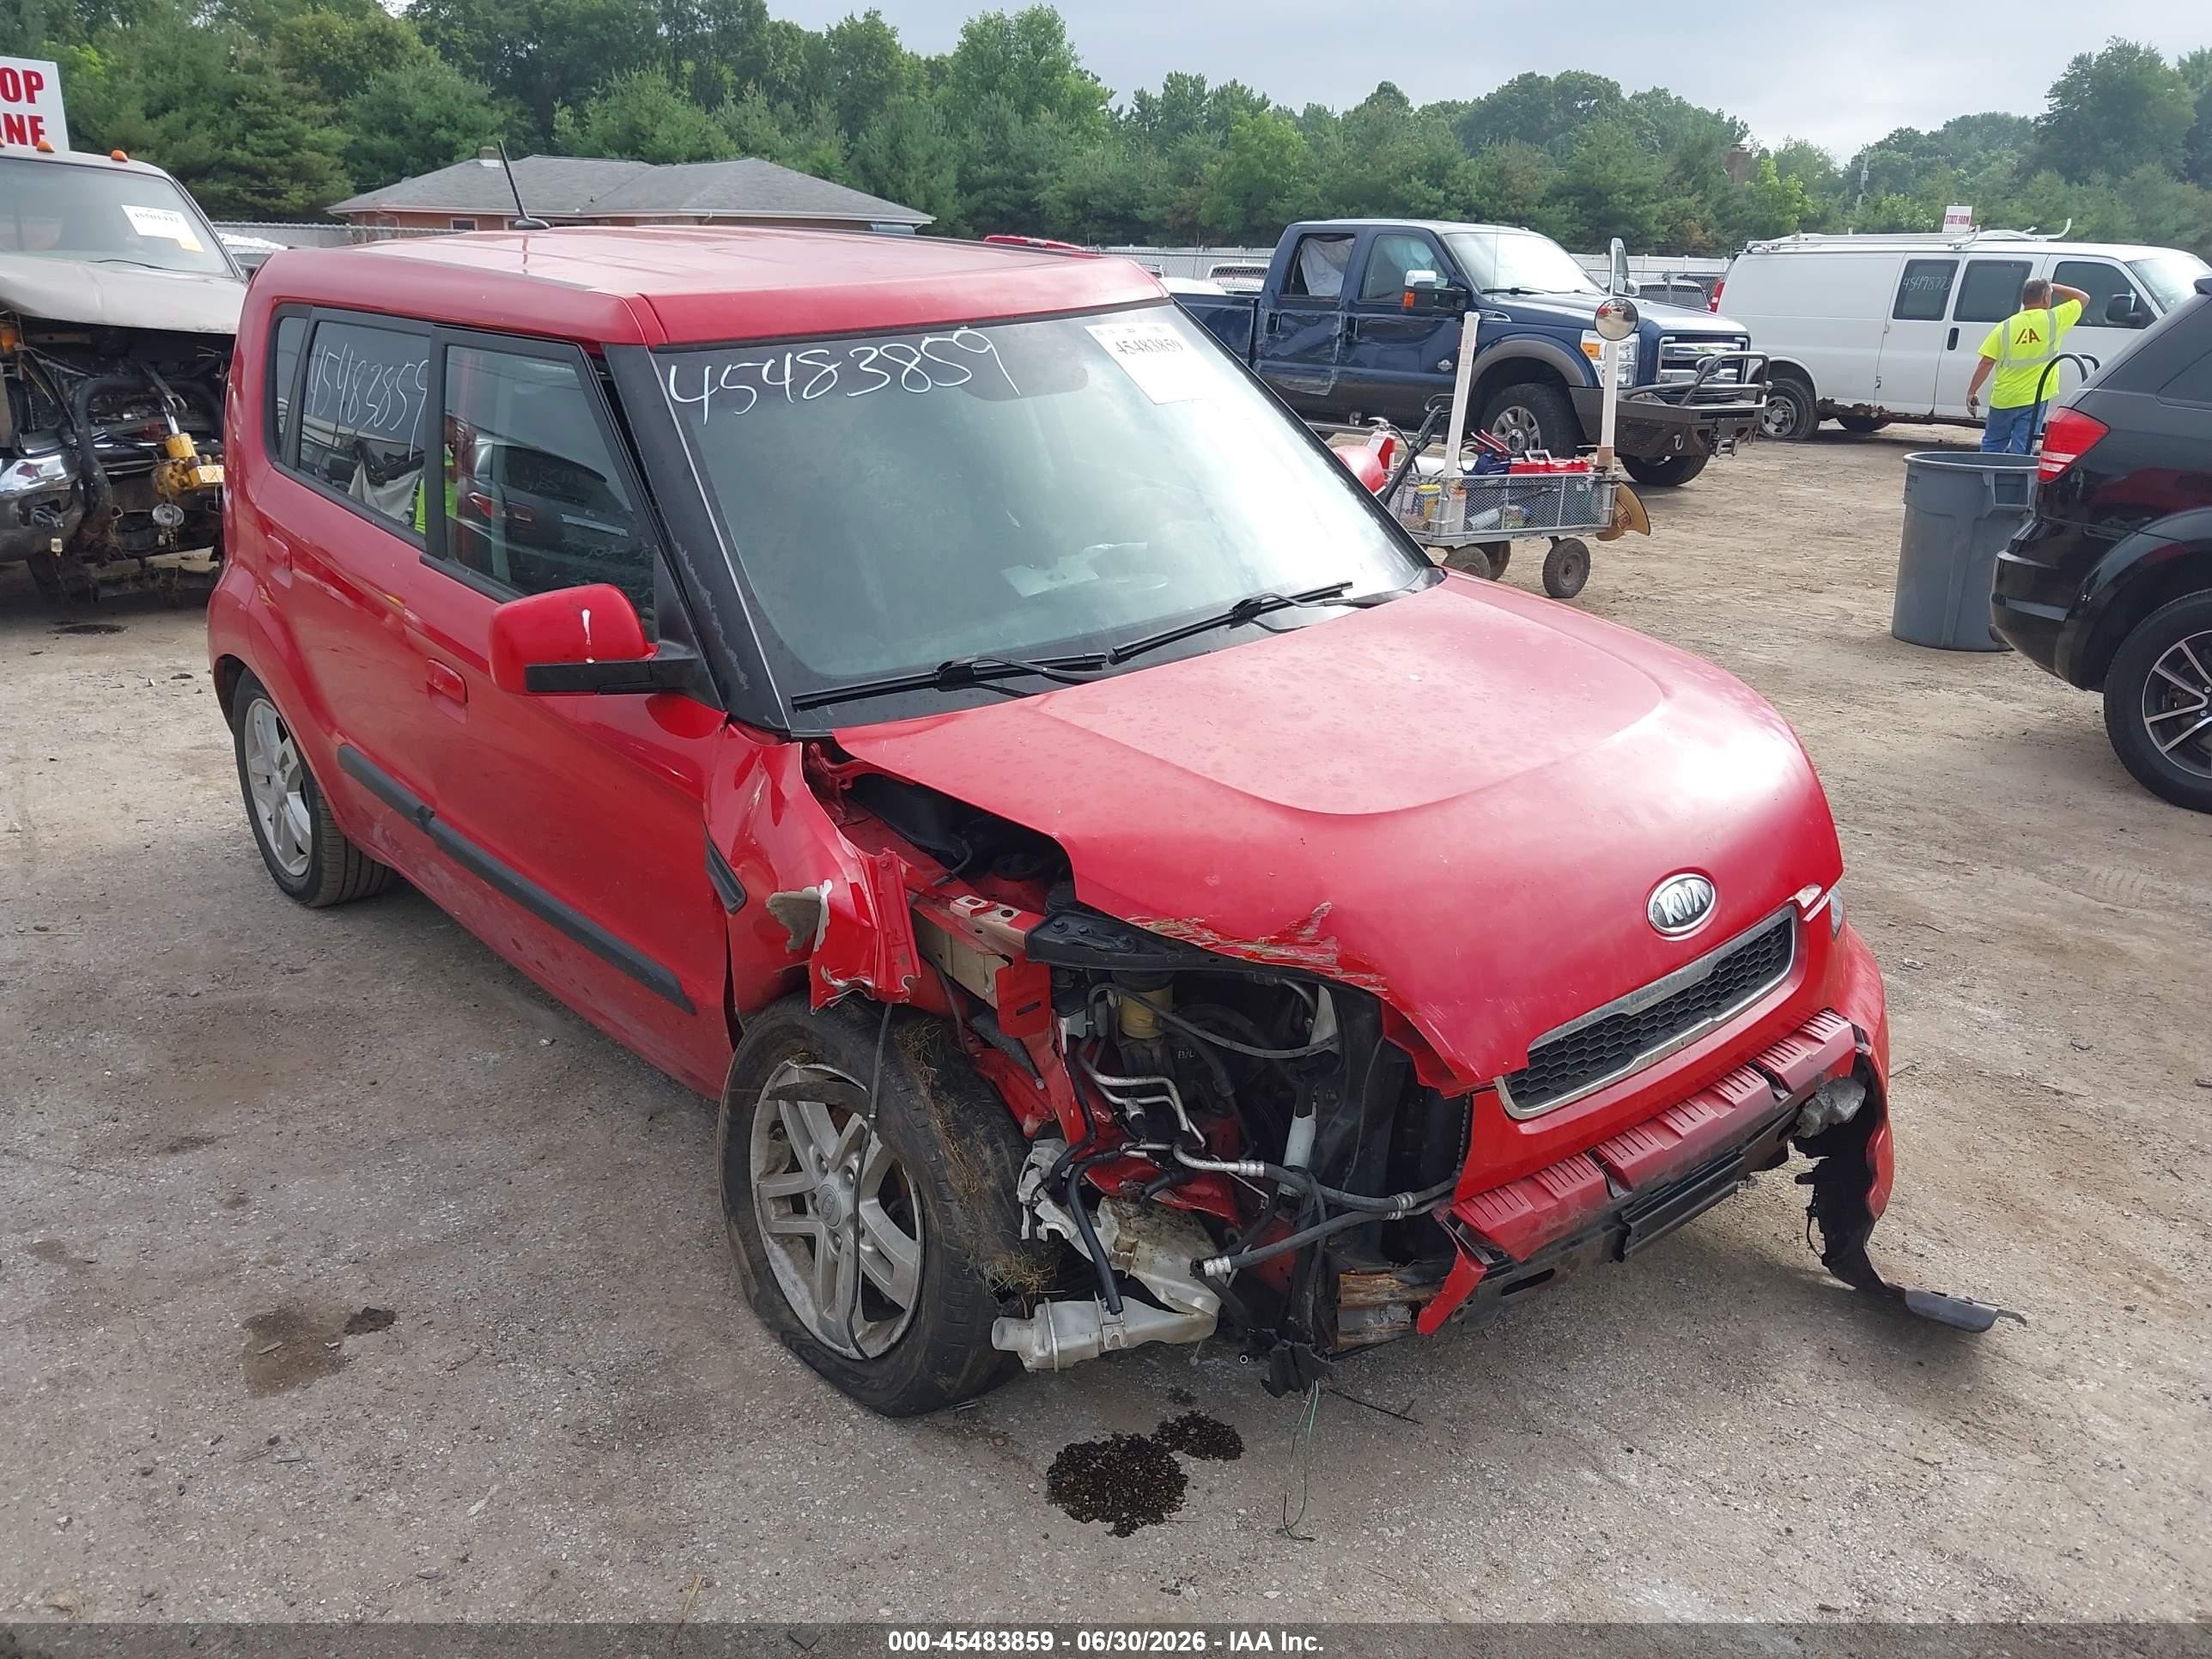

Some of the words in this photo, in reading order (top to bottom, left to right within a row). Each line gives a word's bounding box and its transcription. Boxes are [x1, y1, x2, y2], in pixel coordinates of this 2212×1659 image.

[0, 67, 44, 104] OP
[0, 112, 46, 147] NE
[669, 325, 1021, 425] 45483859
[1656, 881, 1709, 926] KIA
